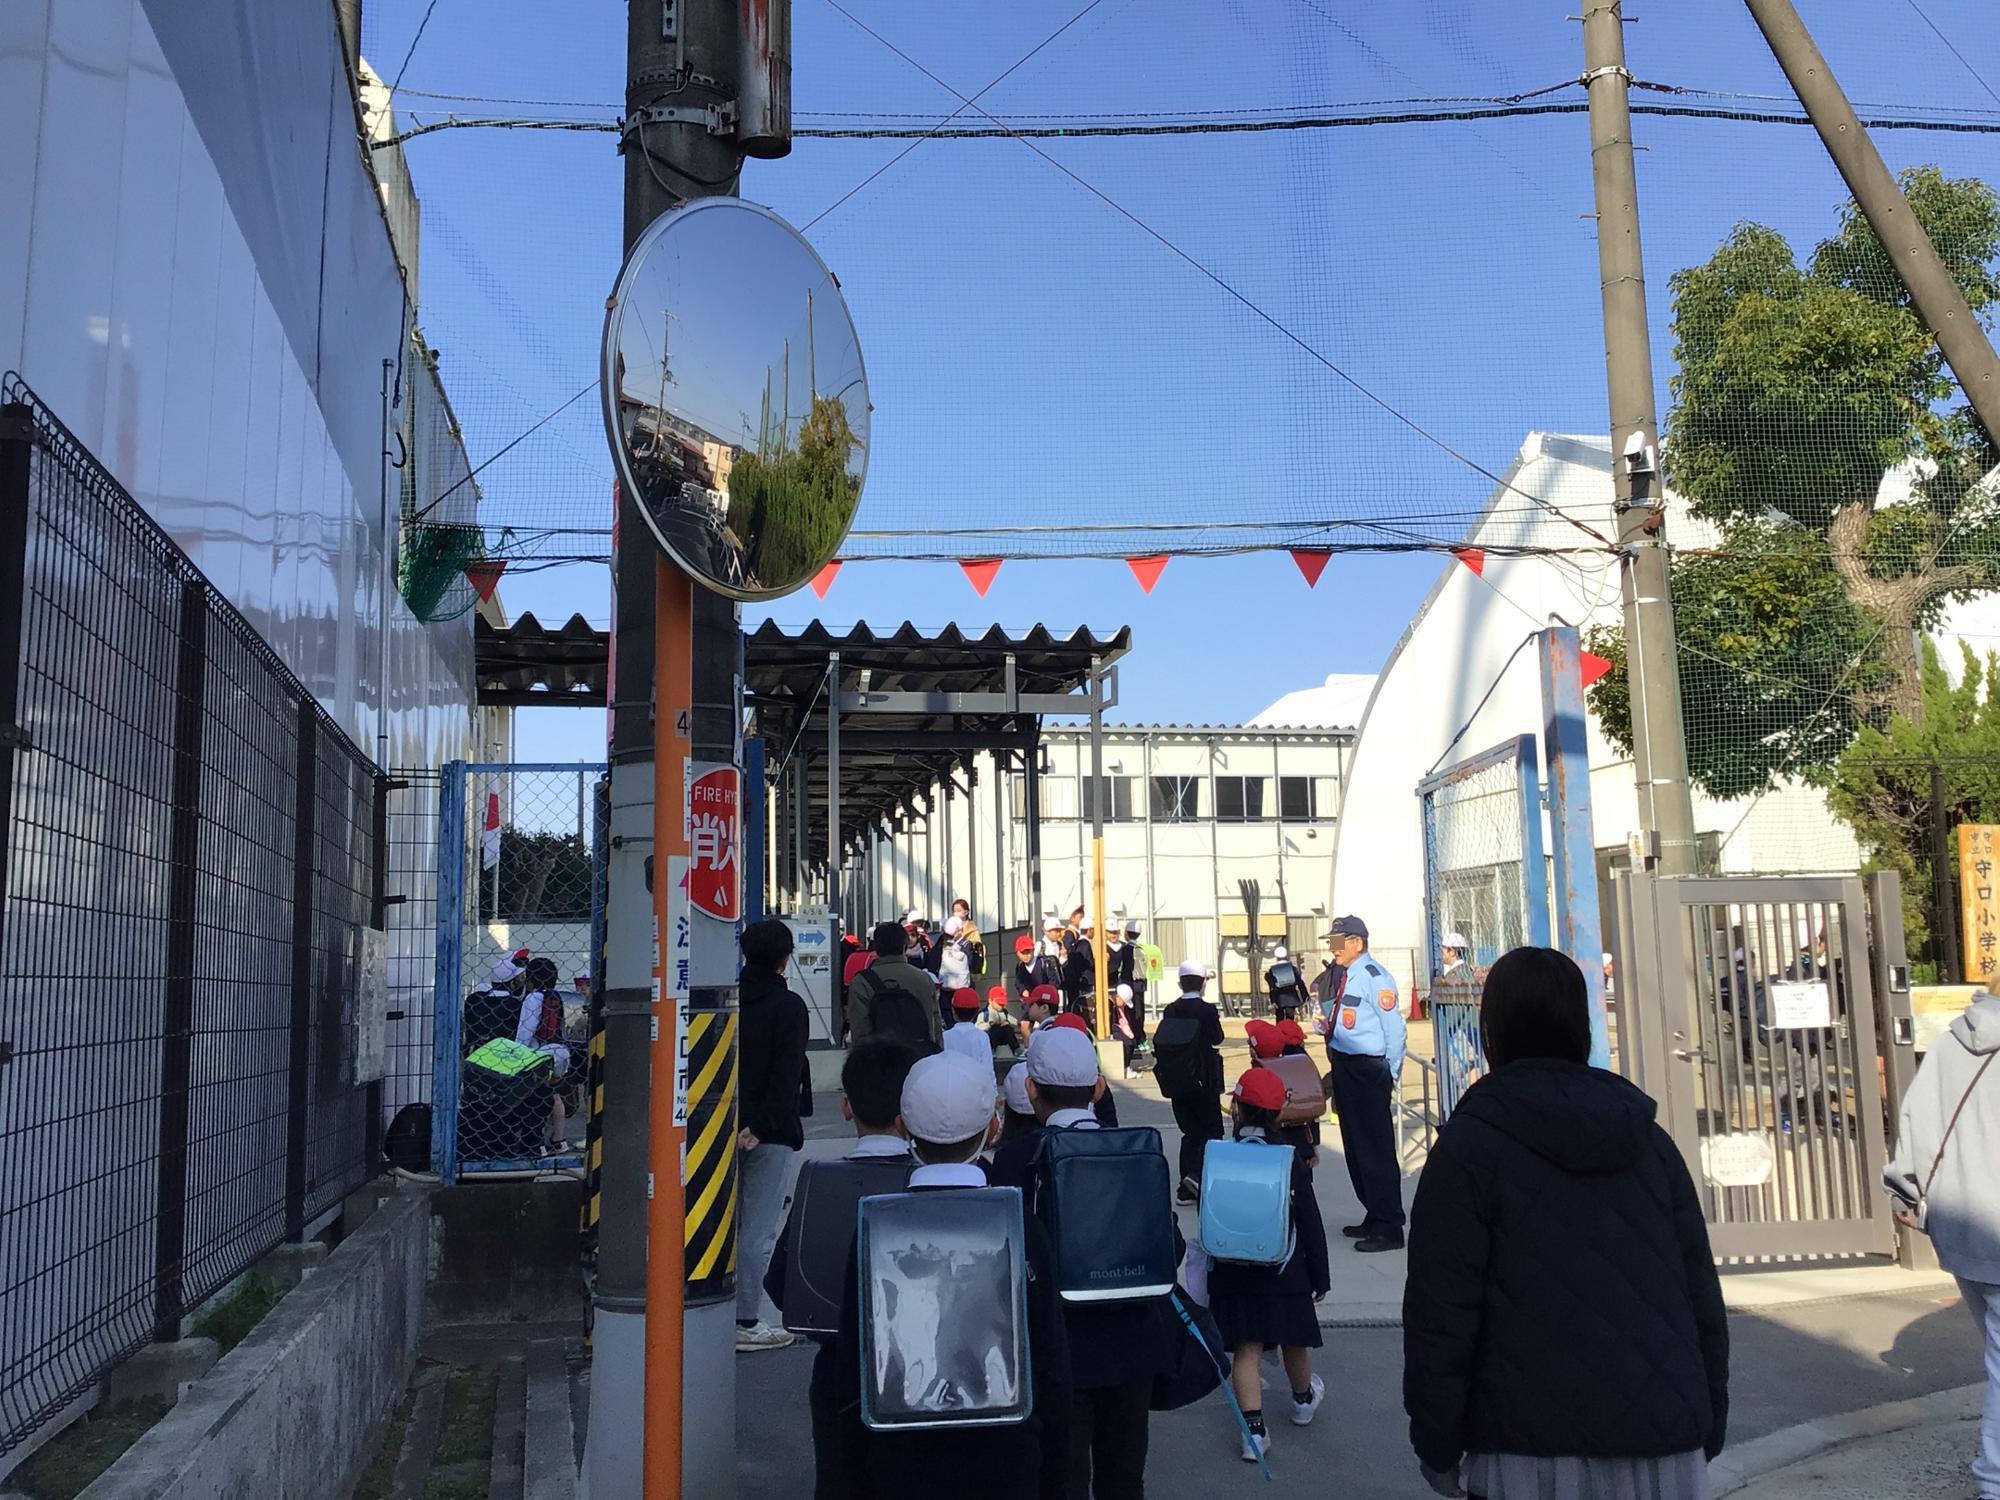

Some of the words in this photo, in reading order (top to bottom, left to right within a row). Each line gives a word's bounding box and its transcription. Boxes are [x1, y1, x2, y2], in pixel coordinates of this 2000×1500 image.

[694, 785, 721, 802] FIRE
[1975, 859, 1997, 975] 守口小学校
